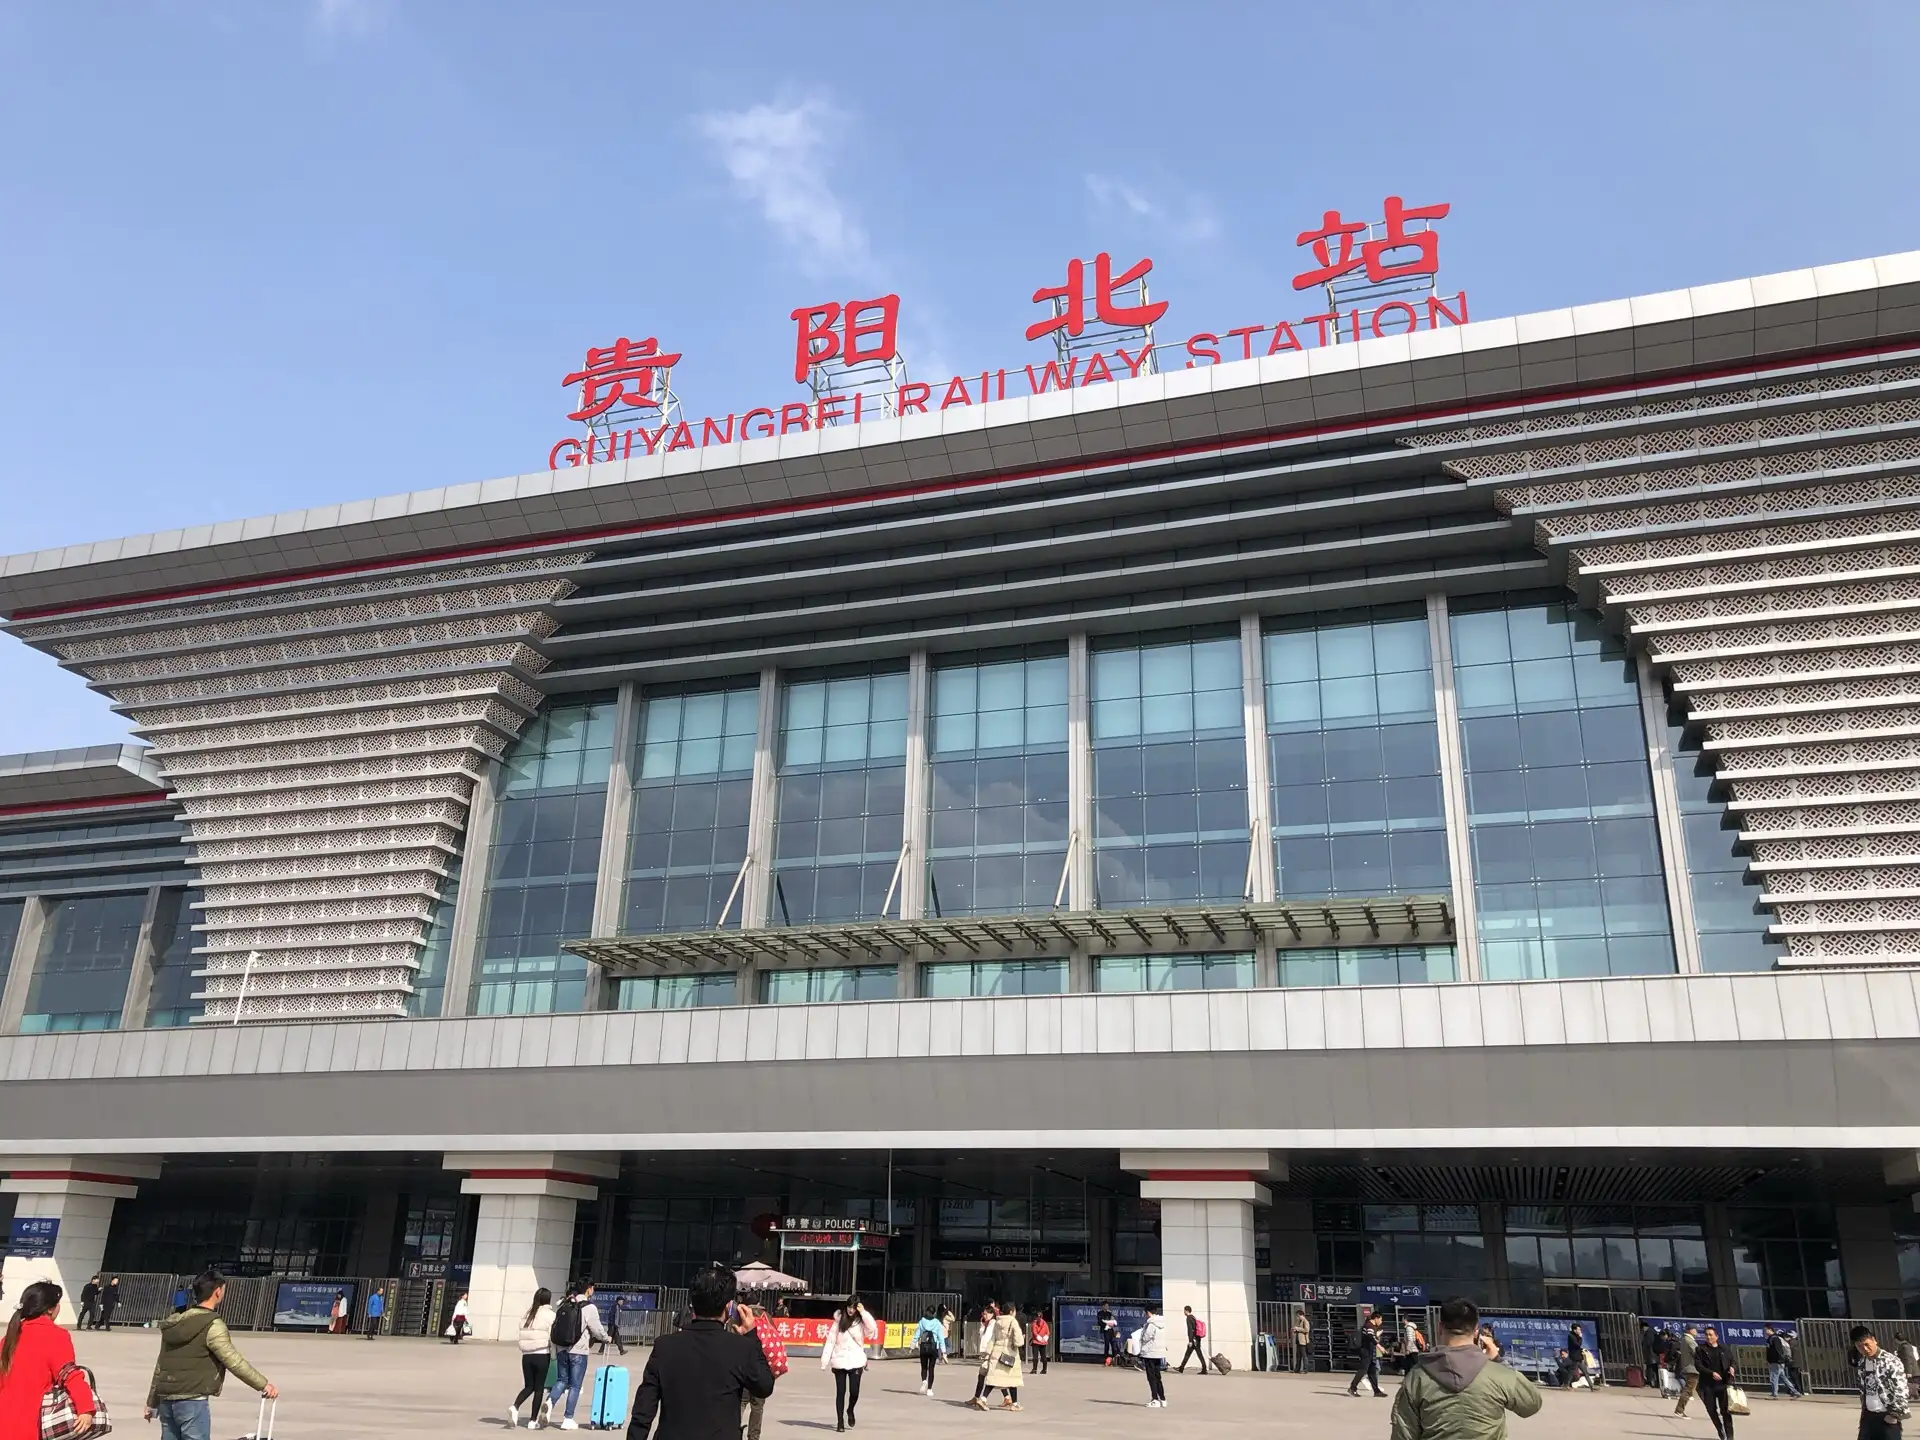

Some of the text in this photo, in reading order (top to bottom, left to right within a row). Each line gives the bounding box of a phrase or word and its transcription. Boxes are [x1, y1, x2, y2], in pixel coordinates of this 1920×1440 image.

[563, 196, 1450, 421] 贵阳北站
[550, 291, 1469, 470] GUIYANGBEI RAILWAY STATION
[786, 1217, 809, 1229] 特警
[825, 1219, 856, 1229] POLICE
[1317, 1285, 1353, 1295] 旅客止步
